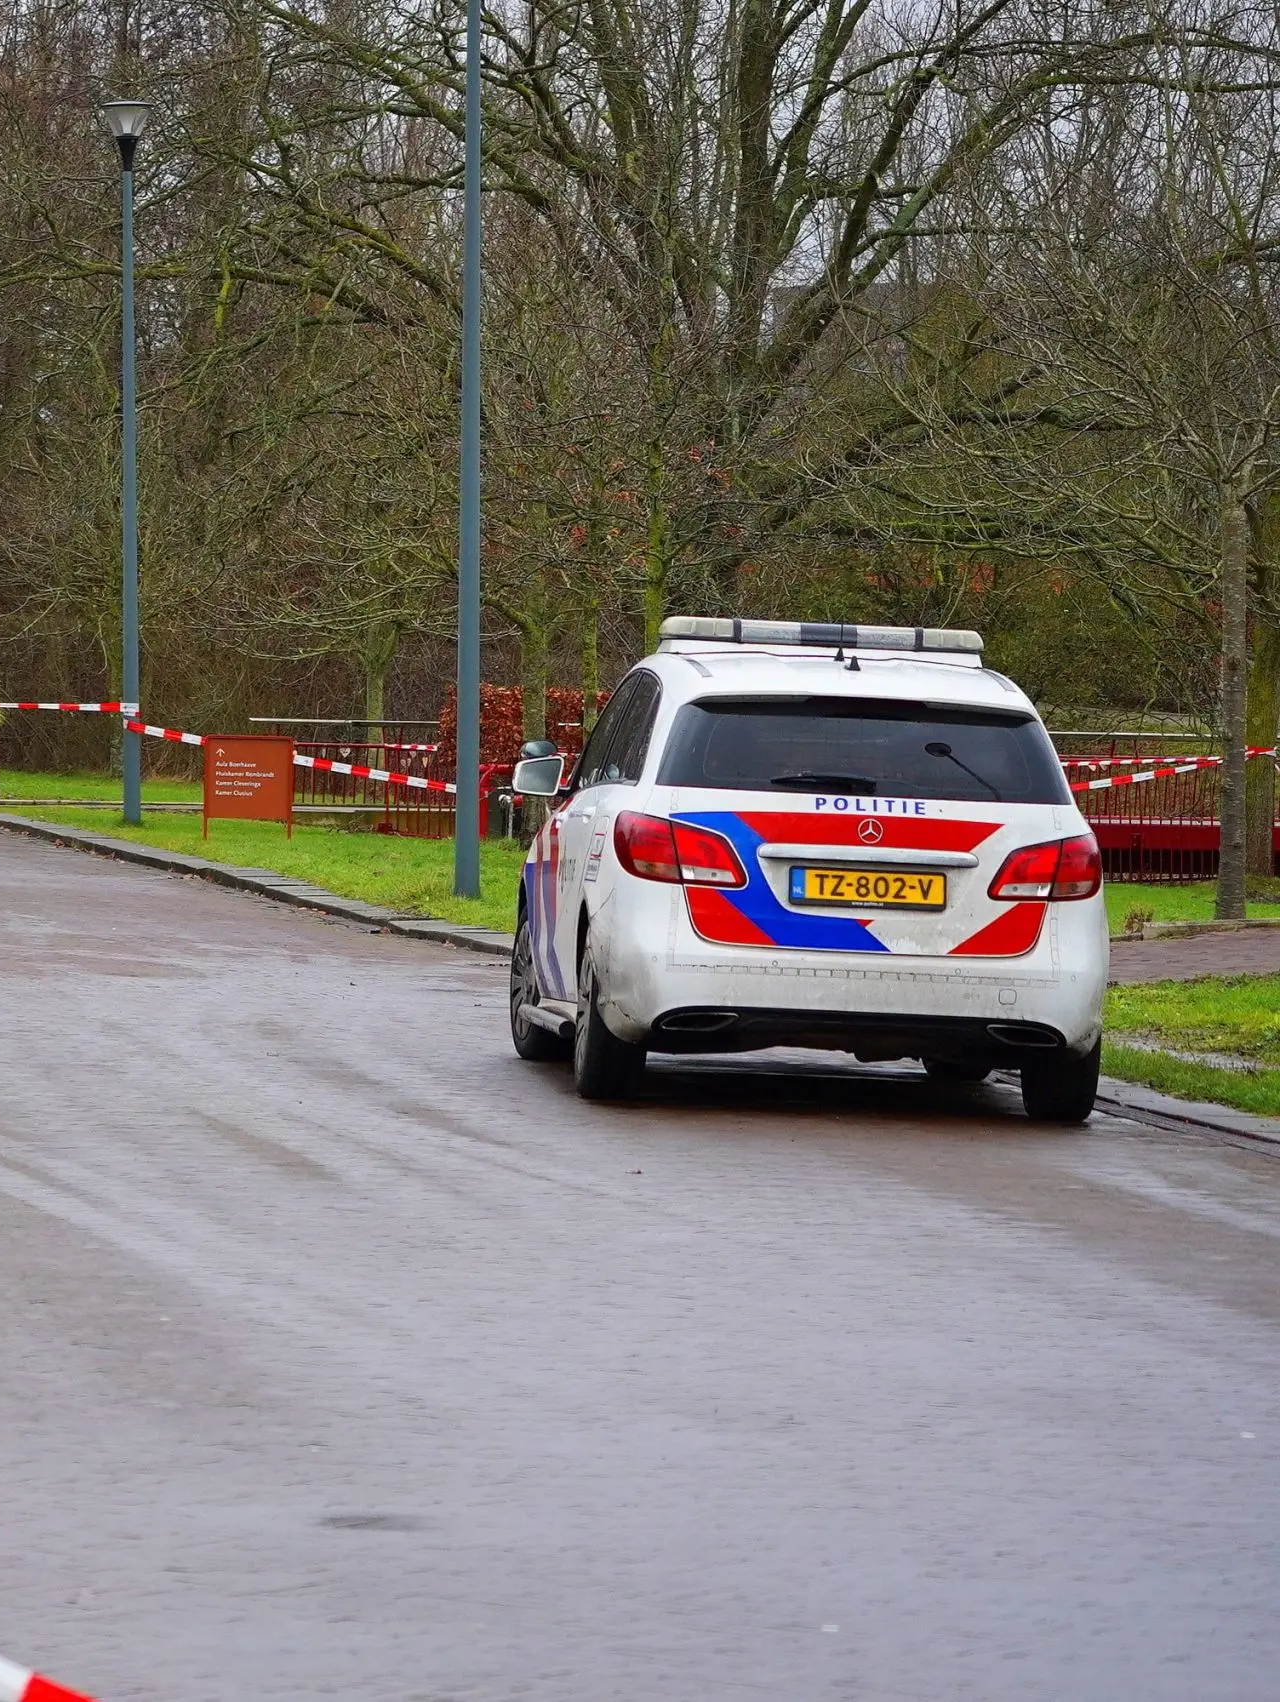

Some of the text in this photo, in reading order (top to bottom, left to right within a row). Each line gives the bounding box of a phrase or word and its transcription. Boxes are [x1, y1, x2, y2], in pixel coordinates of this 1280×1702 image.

[814, 796, 927, 815] POLITIE
[792, 886, 803, 894] NL
[814, 873, 934, 900] TZ-802-V
